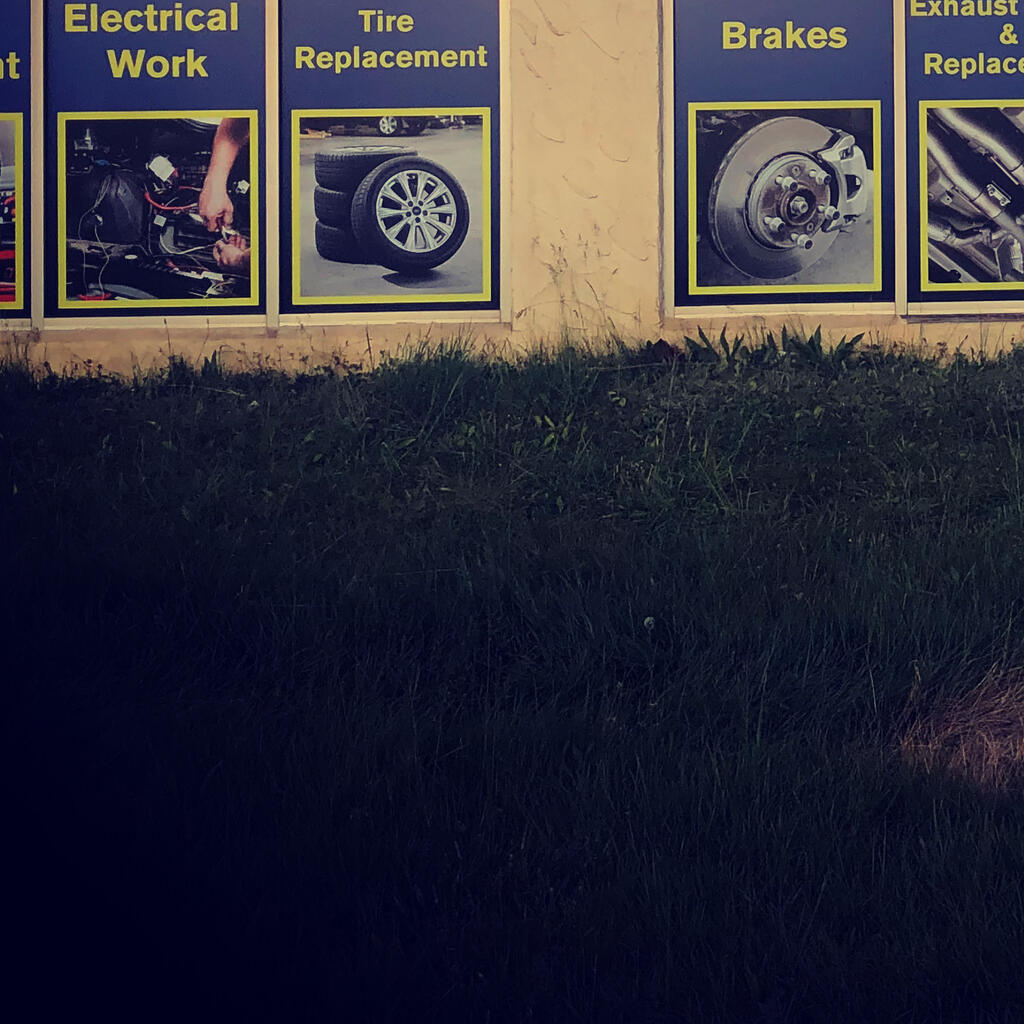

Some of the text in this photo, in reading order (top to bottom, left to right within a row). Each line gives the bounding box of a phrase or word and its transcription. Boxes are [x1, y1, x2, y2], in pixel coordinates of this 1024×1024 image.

[64, 1, 239, 33] Electrical
[358, 9, 414, 33] Tire
[722, 20, 848, 50] Brakes
[999, 23, 1019, 45] &
[106, 48, 209, 79] Work
[295, 45, 488, 74] Replacement
